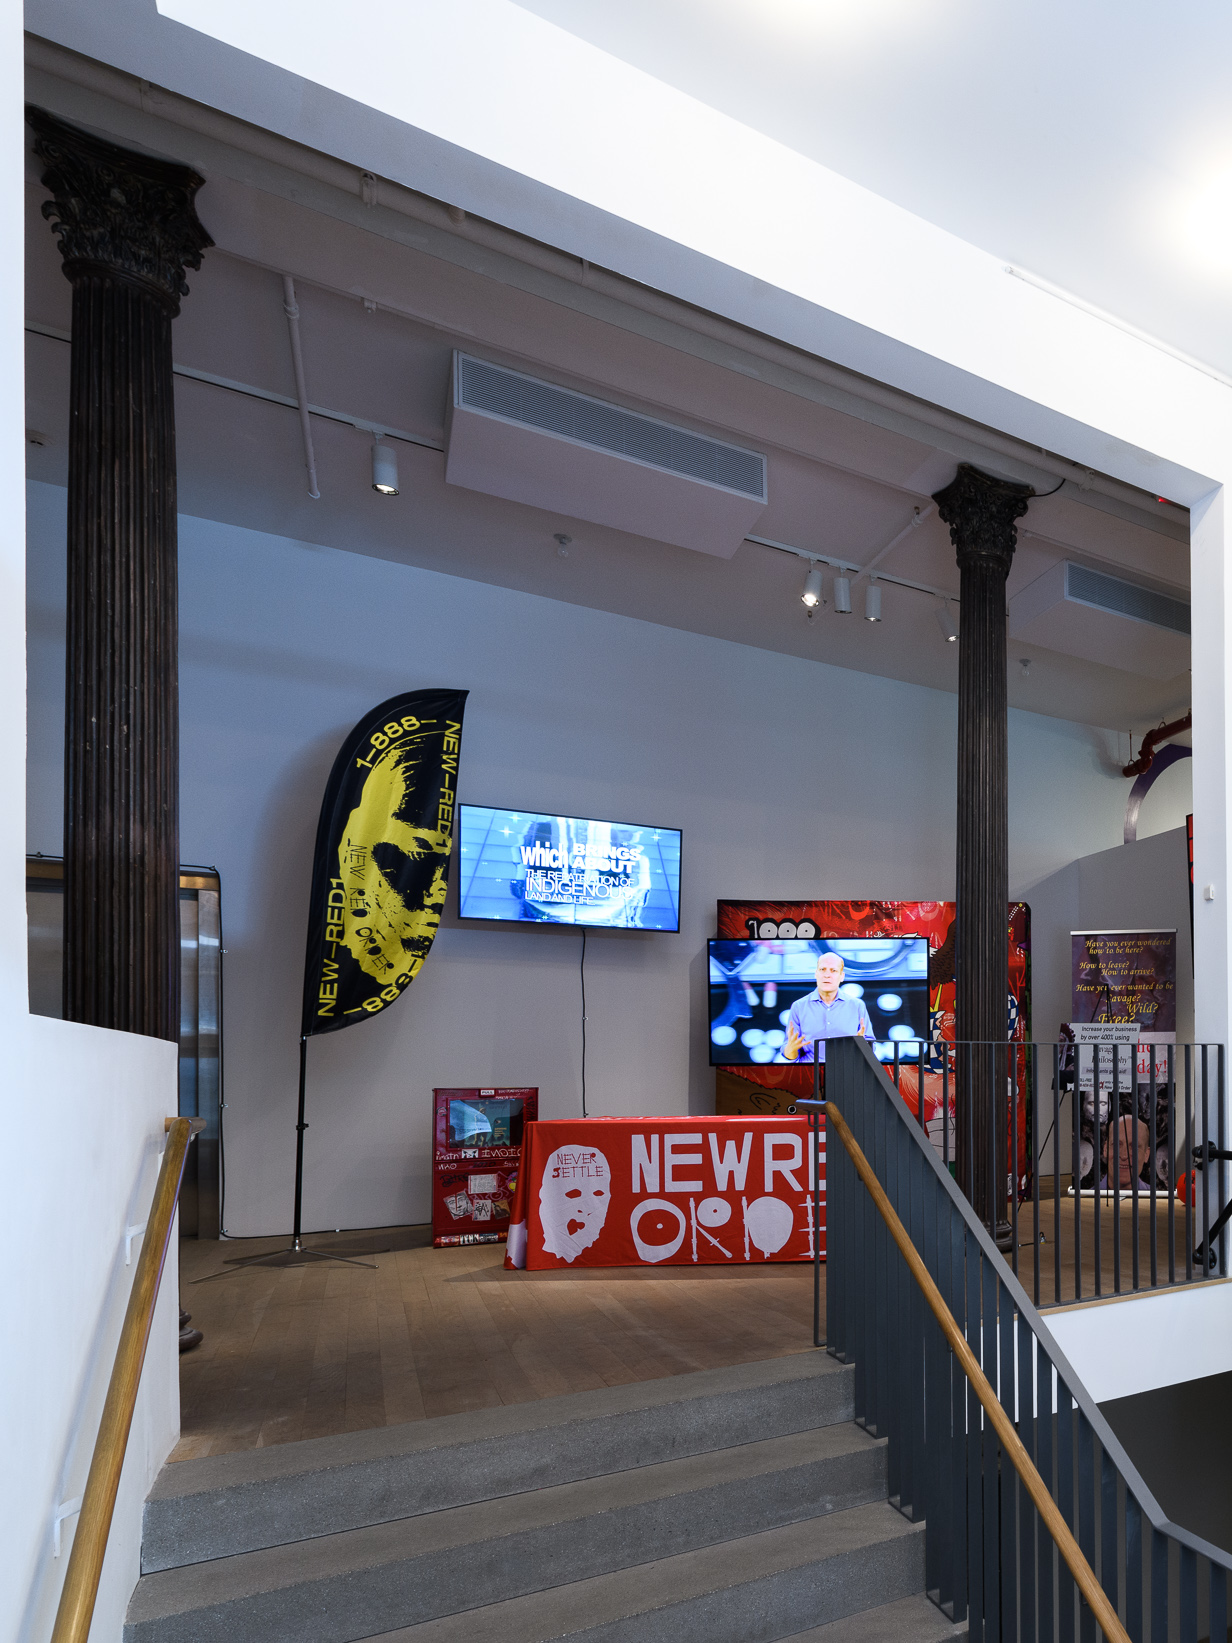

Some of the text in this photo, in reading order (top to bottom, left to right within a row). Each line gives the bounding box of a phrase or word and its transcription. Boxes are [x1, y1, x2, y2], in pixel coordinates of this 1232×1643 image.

[435, 719, 462, 848] NEW-RED1
[520, 841, 641, 869] which BRINGS
[571, 856, 636, 873] ABOUT
[525, 869, 635, 887] THE REPATRIATION OF
[525, 877, 634, 900] INDIGENOUS
[524, 891, 551, 902] LAND
[317, 877, 346, 1017] NEW-RED1
[1085, 940, 1104, 948] Have
[1105, 941, 1119, 949] you
[1137, 938, 1171, 946] wondered
[1089, 946, 1104, 955] how
[1115, 946, 1123, 954] be
[1125, 946, 1144, 954] here?
[1107, 961, 1130, 969] leave?
[1100, 968, 1119, 976] How
[1075, 984, 1095, 992] Have
[1127, 982, 1154, 991] wanted
[1165, 981, 1174, 990] be
[1126, 1003, 1159, 1014] Wild?
[1098, 1013, 1136, 1024] Free?
[1080, 1034, 1087, 1042] by
[1114, 1034, 1130, 1042] using
[556, 1152, 598, 1165] NEVER
[551, 1165, 604, 1179] SETTLE
